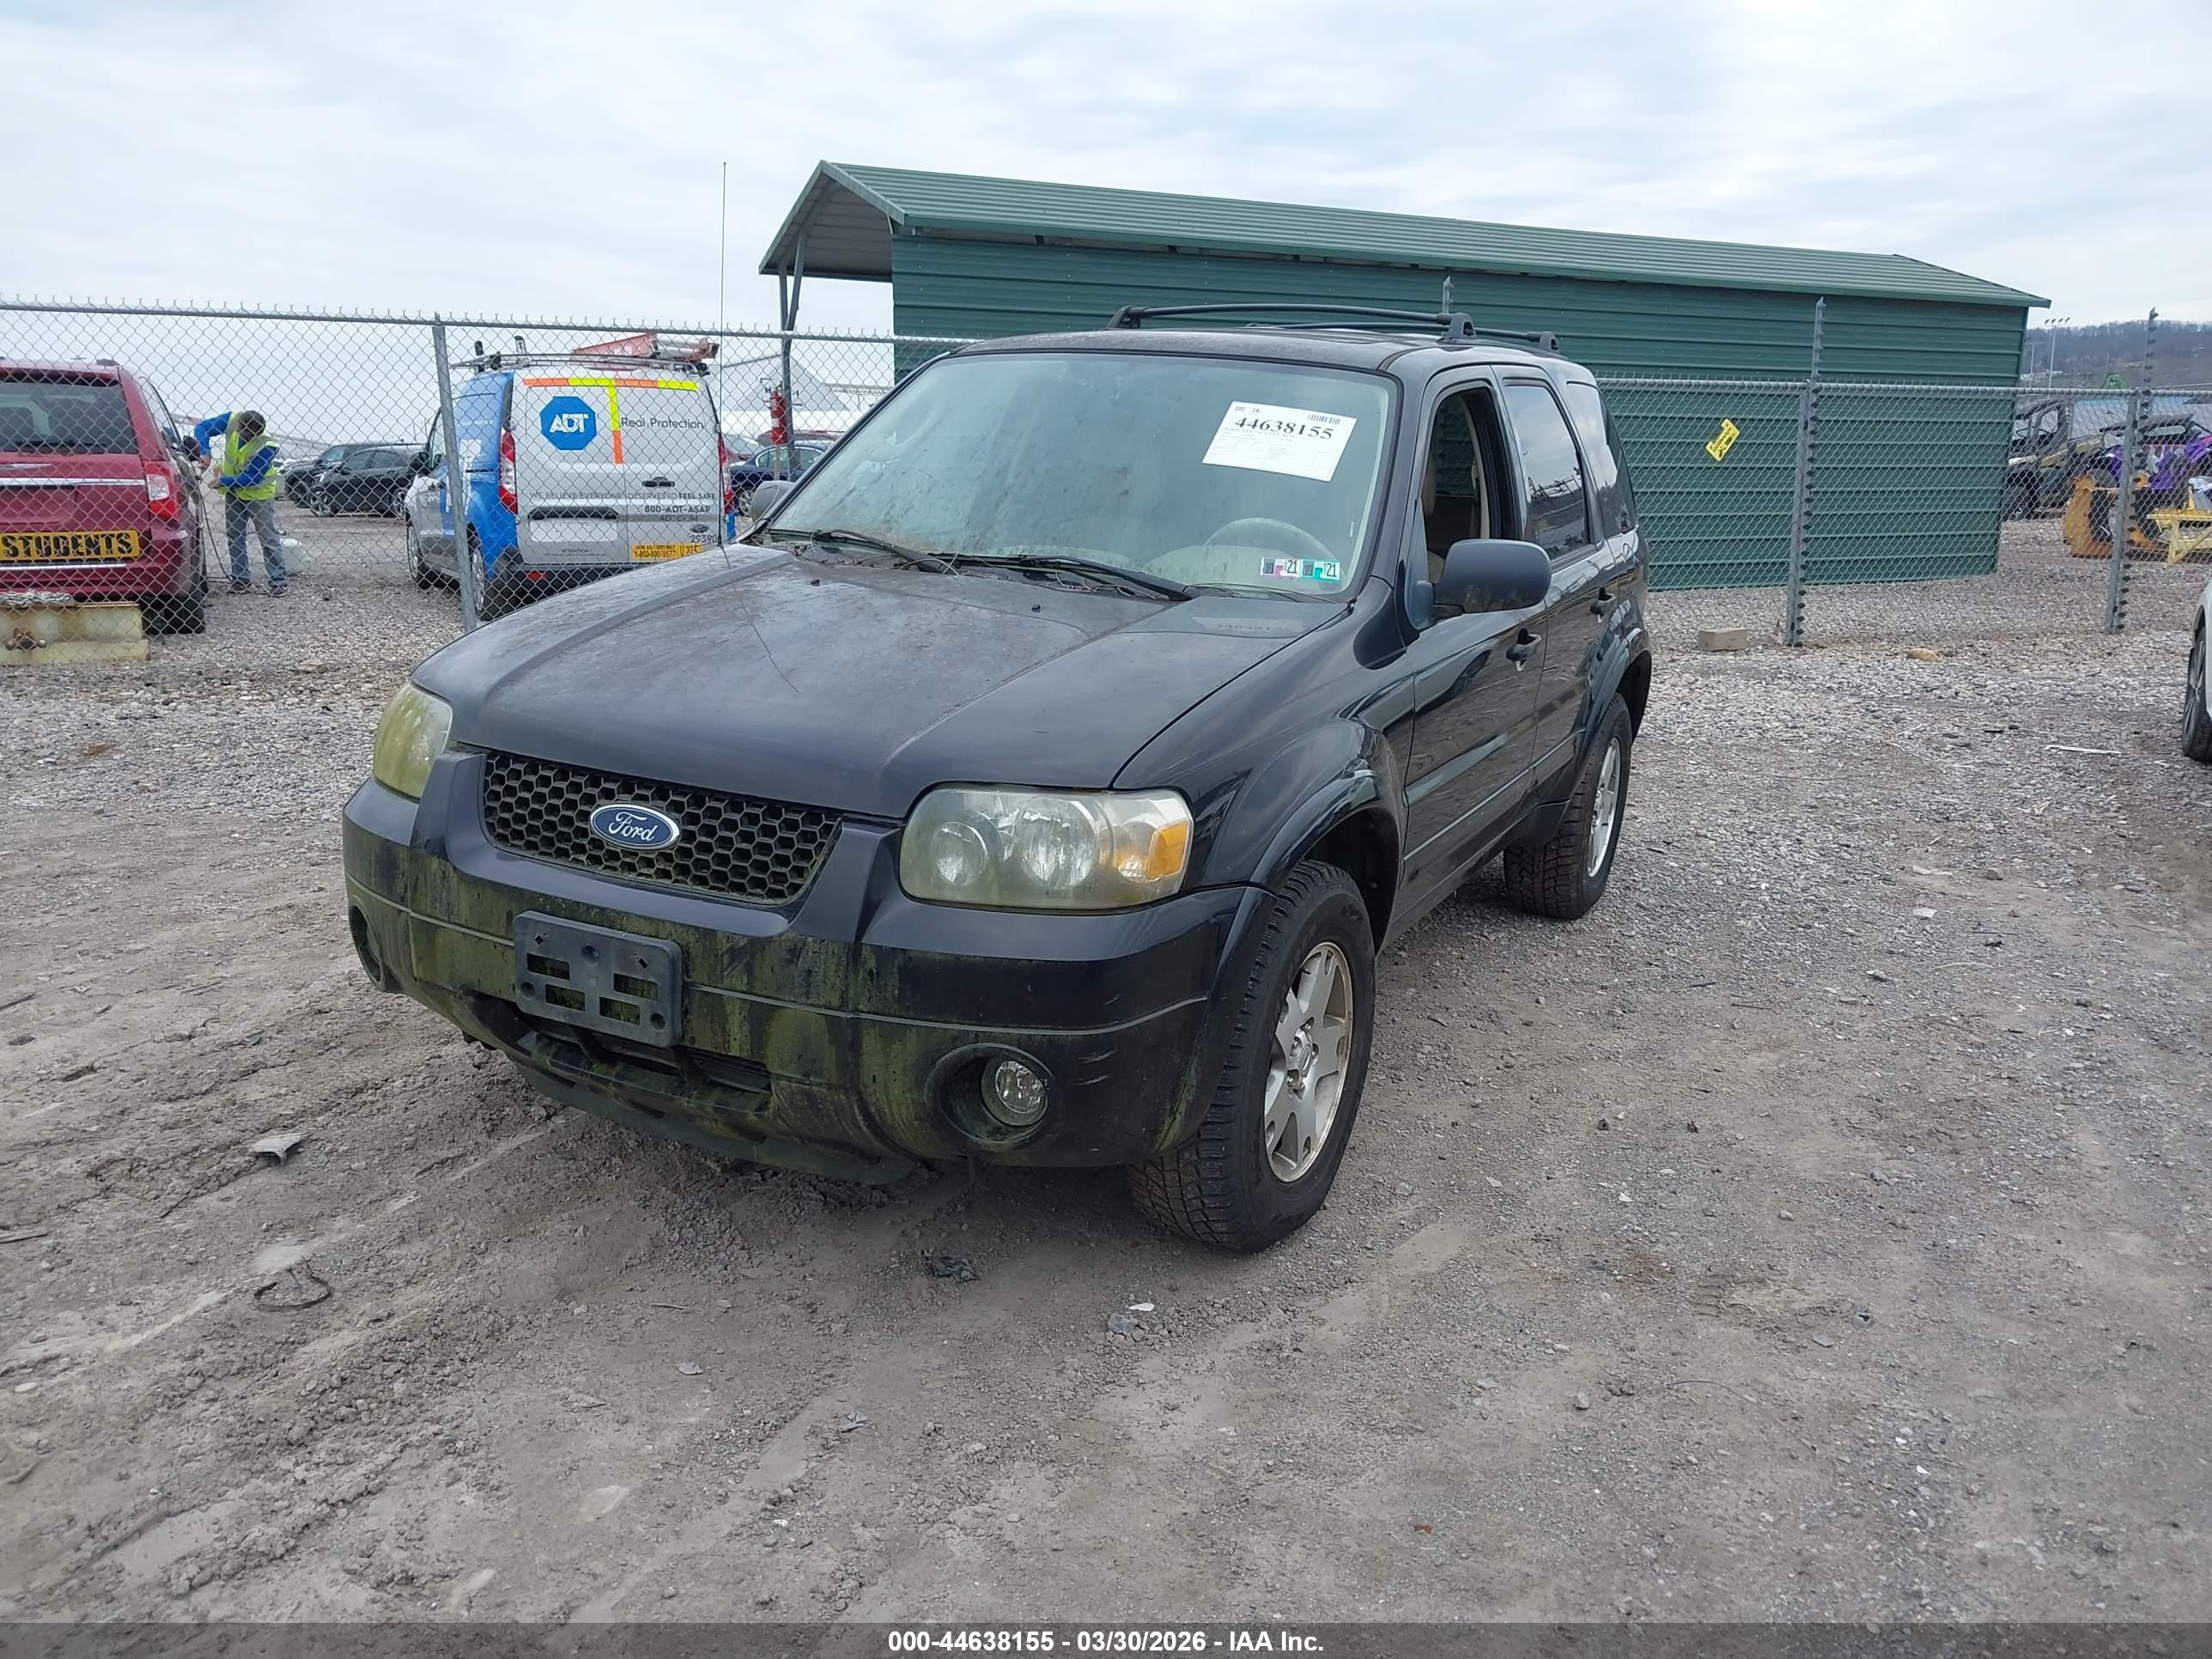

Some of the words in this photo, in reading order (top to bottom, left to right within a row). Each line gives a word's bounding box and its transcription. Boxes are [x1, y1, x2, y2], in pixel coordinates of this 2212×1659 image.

[549, 412, 589, 433] ADT
[621, 417, 645, 428] Real
[650, 417, 705, 429] Protection
[1234, 416, 1335, 440] 44638155
[644, 505, 711, 514] 800-ADT-ASAP
[1, 532, 133, 558] STUDENTS
[690, 534, 718, 544] 29390
[1286, 559, 1298, 574] 21
[608, 811, 659, 842] Ford
